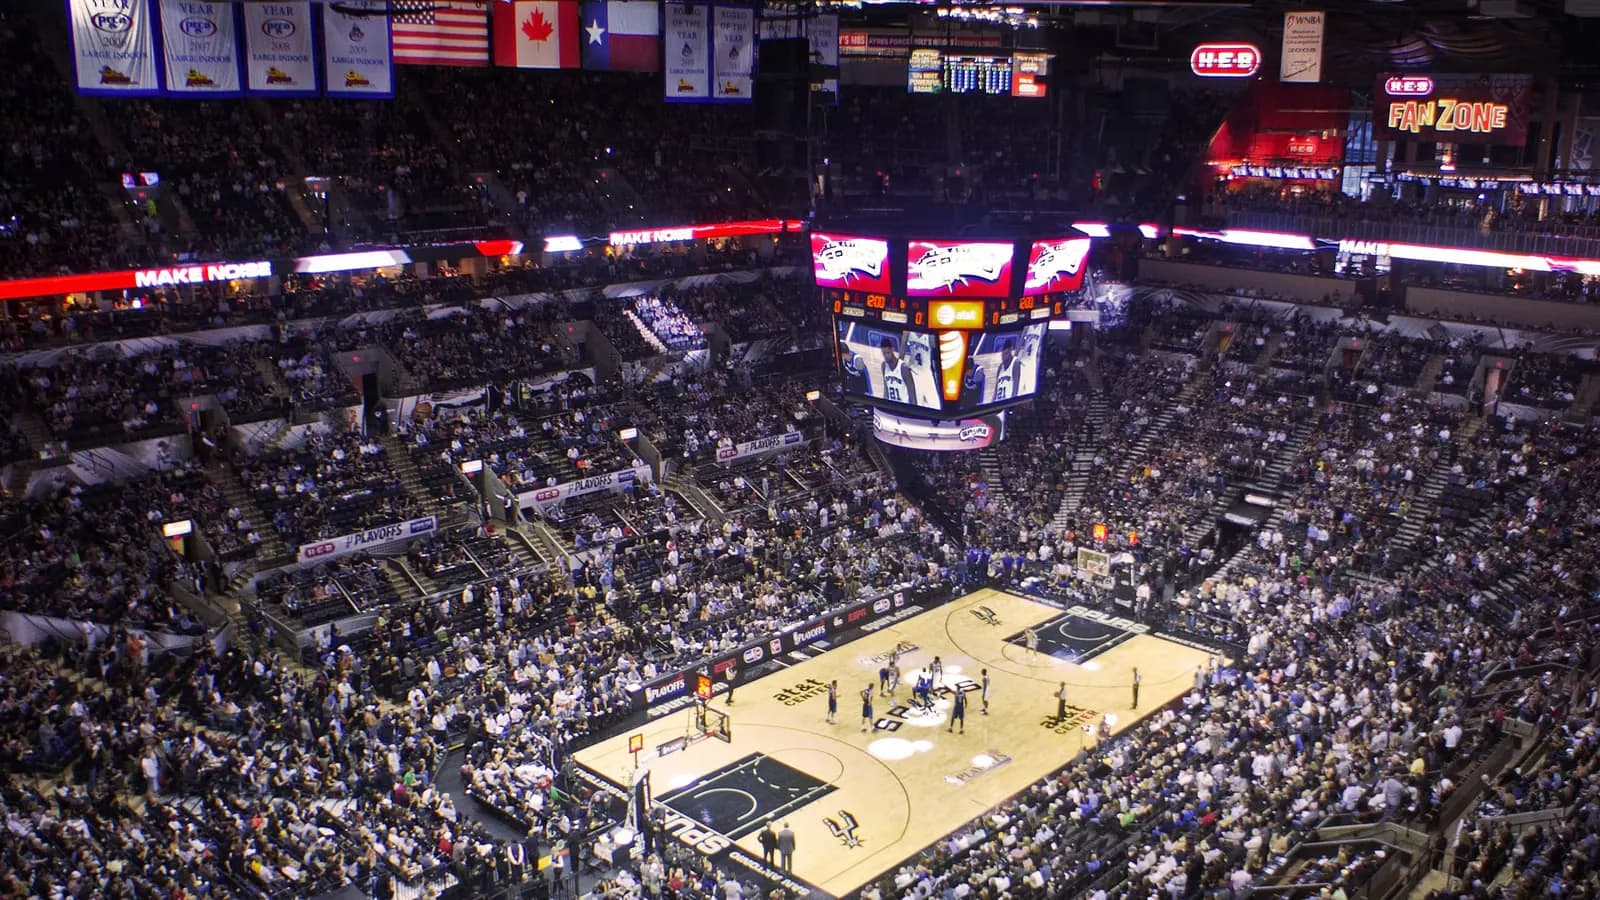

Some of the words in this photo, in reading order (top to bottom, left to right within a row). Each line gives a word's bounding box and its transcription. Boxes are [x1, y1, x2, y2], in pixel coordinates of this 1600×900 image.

[179, 2, 214, 14] YEAR
[261, 5, 295, 16] YEAR
[1295, 15, 1321, 25] WNBA
[677, 31, 698, 40] YEAR
[81, 49, 109, 59] LARGE
[198, 55, 232, 64] INDOOR
[253, 53, 277, 63] LARGE
[280, 54, 309, 63] INDOOR
[1388, 100, 1435, 133] FAN
[1435, 98, 1509, 133] ZONE
[609, 231, 651, 247] MAKE
[134, 266, 203, 288] MAKE
[208, 261, 272, 281] NOISE
[915, 352, 923, 367] 4
[889, 386, 902, 400] 21
[750, 435, 781, 452] PLAYOFFS
[574, 474, 613, 492] PLAYOFFS
[354, 523, 403, 546] PLAYOFFS
[1065, 605, 1151, 634] SPURS
[798, 624, 826, 643] PLAYOFFS
[652, 678, 686, 700] PLAYOFFS
[772, 678, 825, 702] at&t
[1054, 709, 1101, 735] CENTER
[728, 850, 784, 882] ANTONIO
